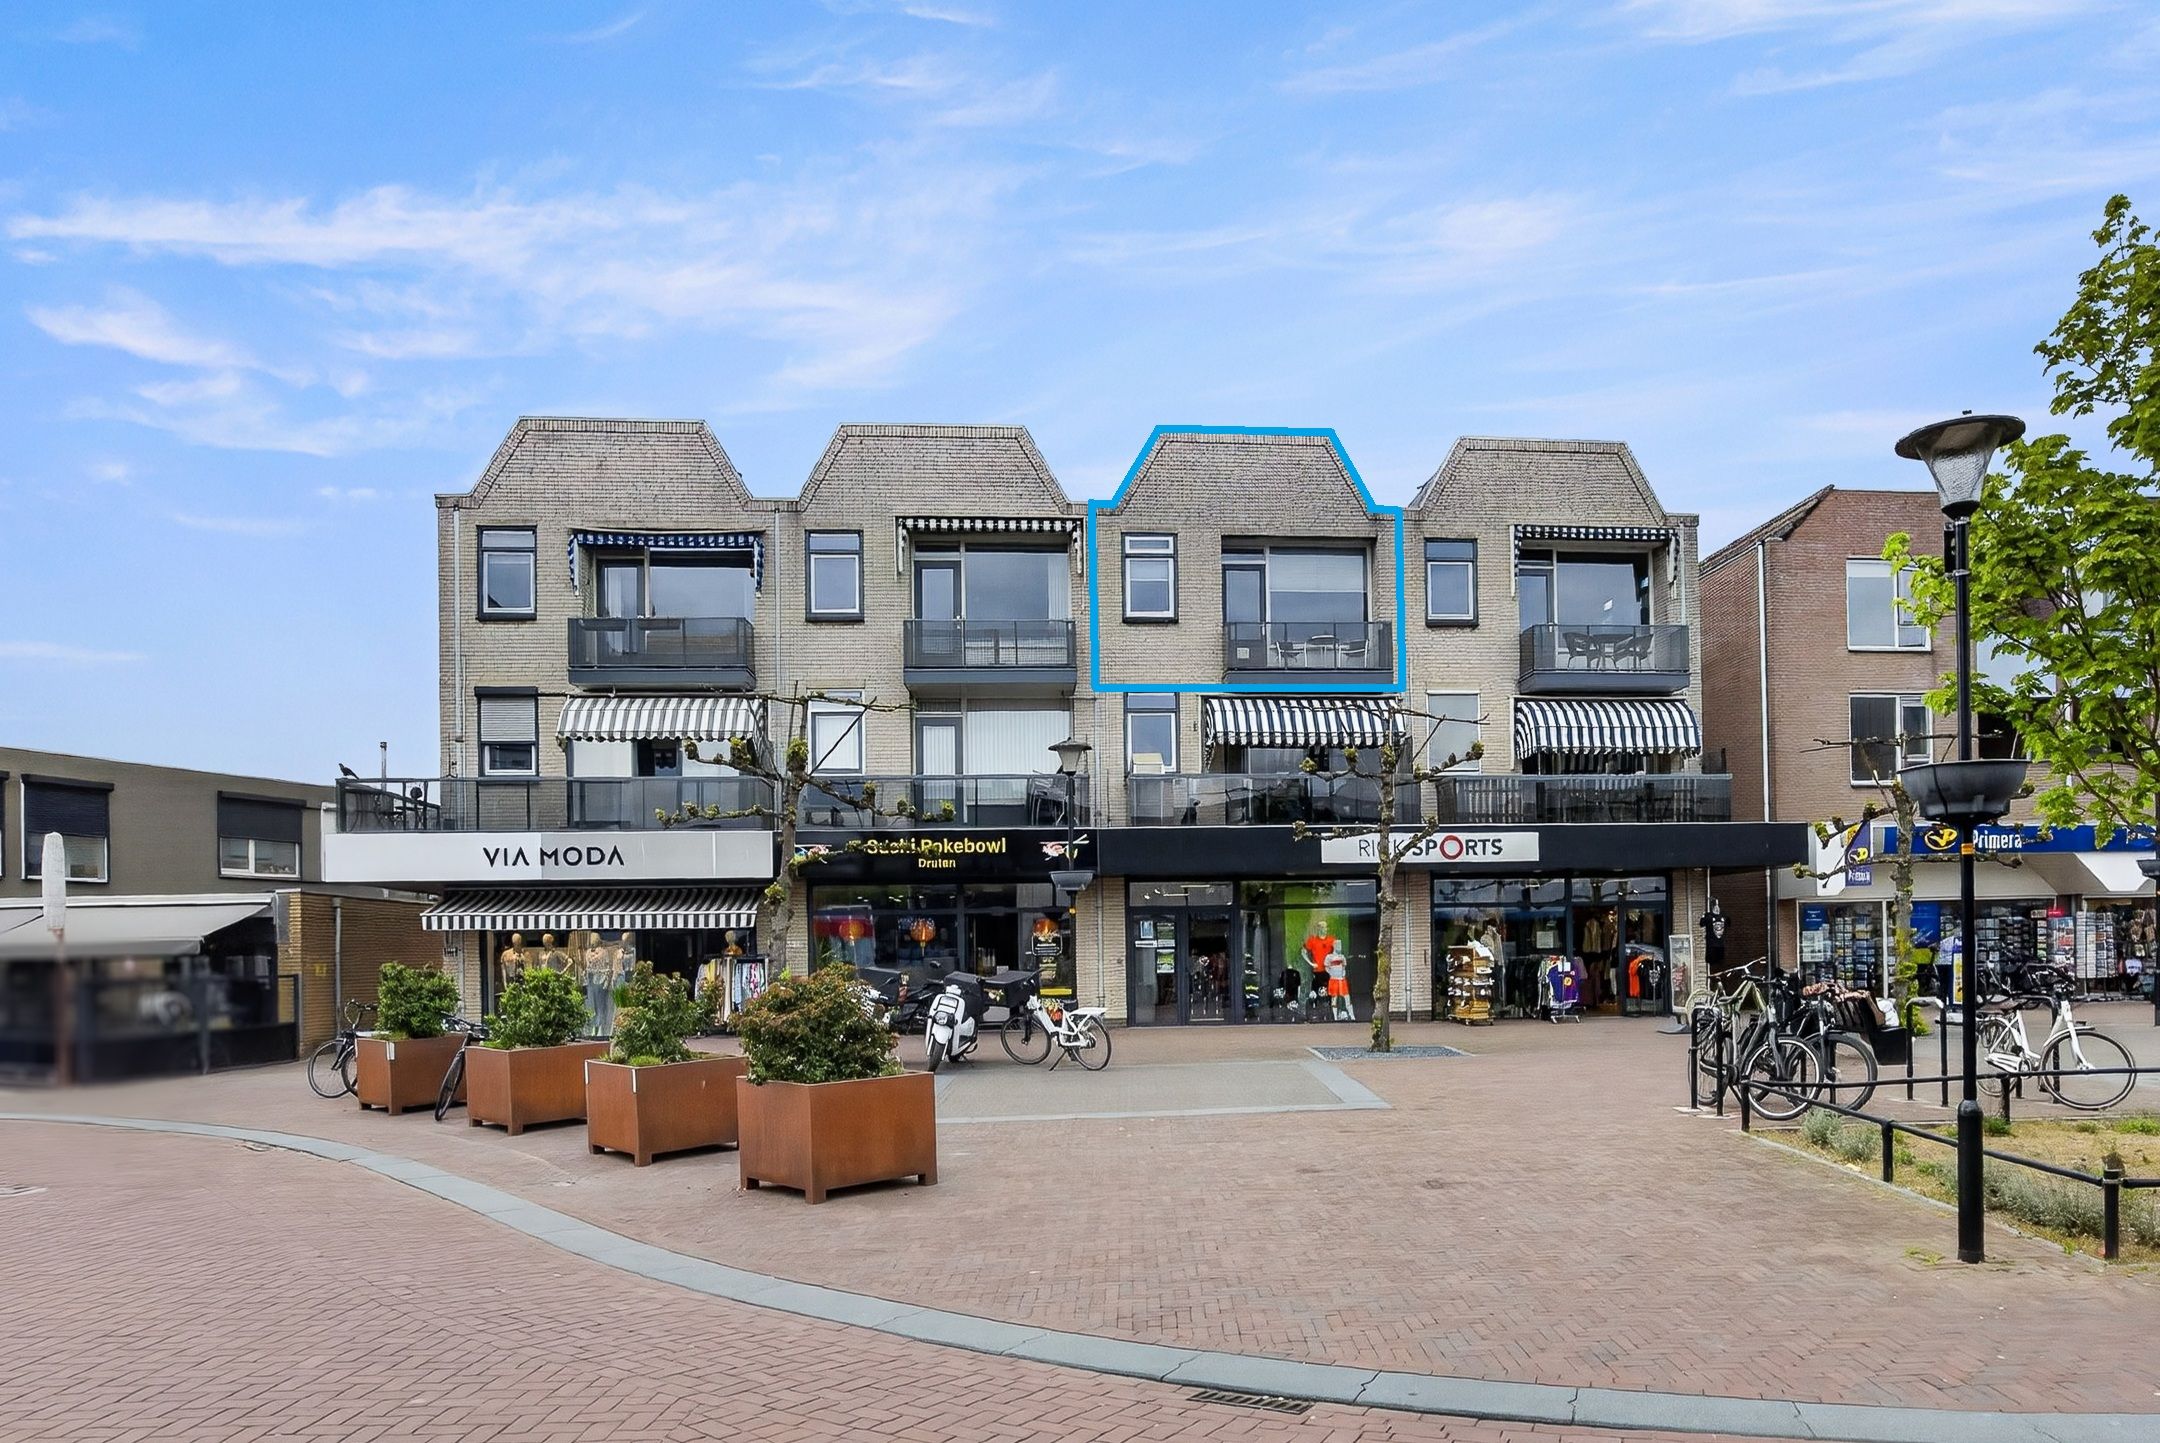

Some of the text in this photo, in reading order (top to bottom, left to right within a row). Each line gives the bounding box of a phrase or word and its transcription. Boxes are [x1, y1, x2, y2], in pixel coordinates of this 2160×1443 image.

[920, 837, 1007, 854] Pokebowl
[1973, 829, 2022, 849] Primera
[482, 845, 625, 868] VIA MODA
